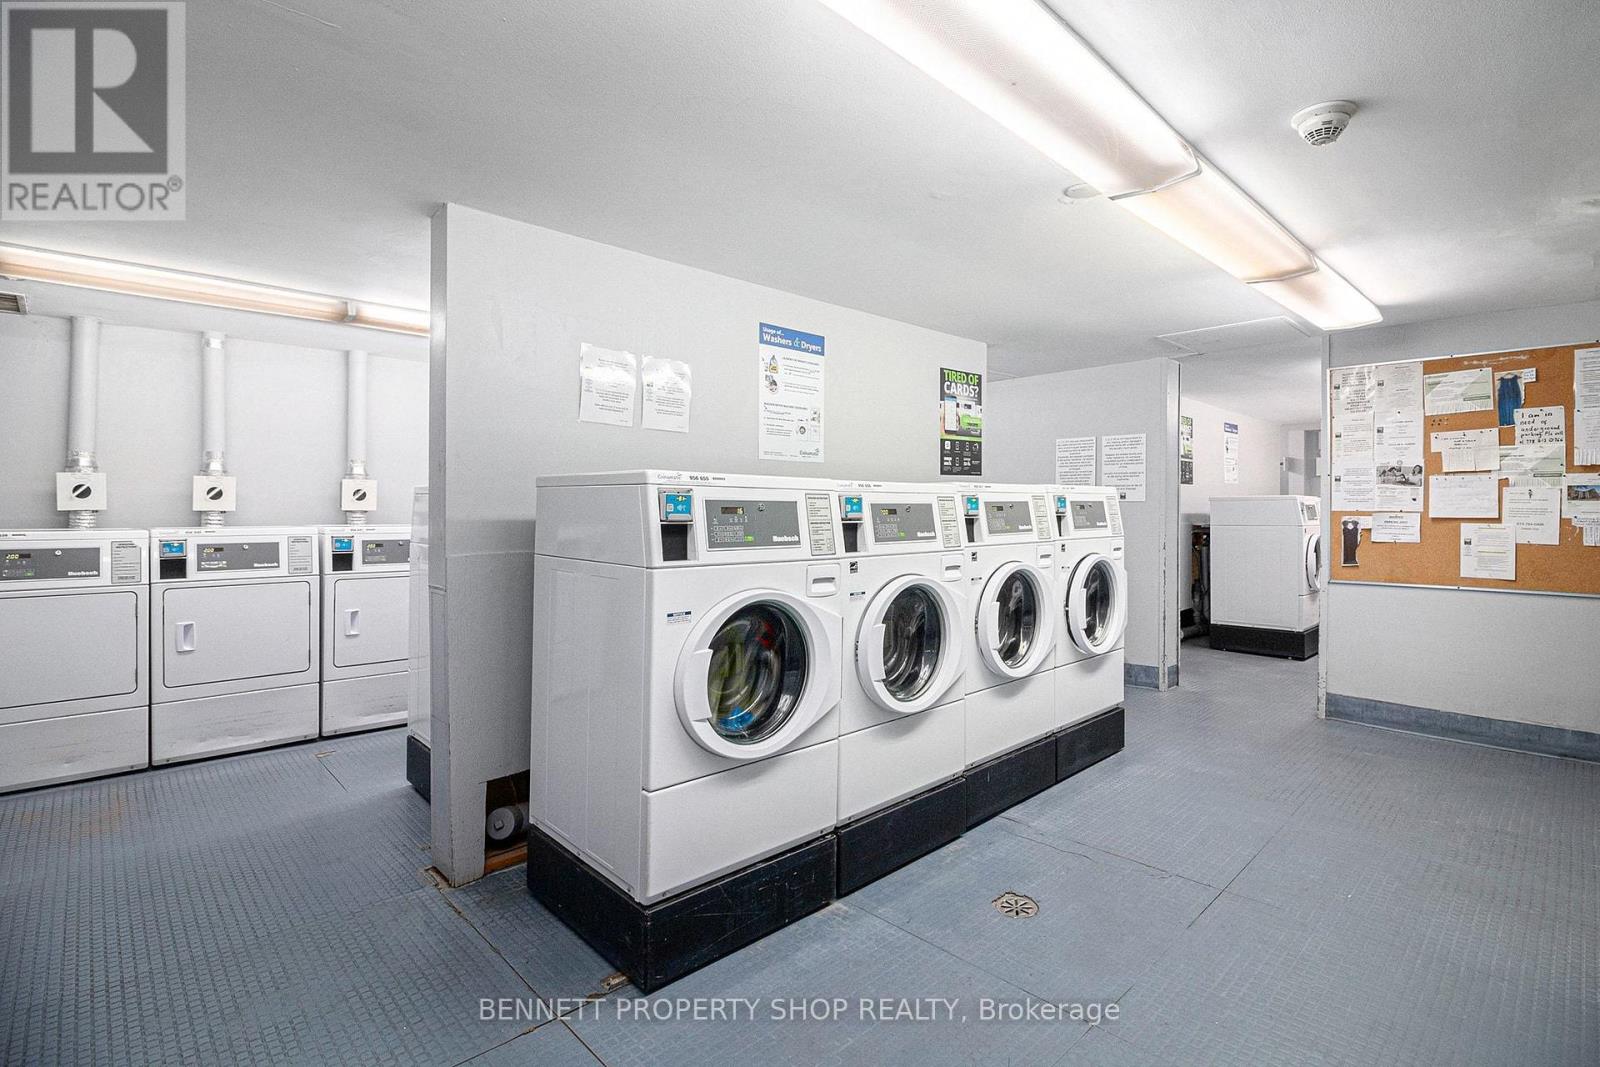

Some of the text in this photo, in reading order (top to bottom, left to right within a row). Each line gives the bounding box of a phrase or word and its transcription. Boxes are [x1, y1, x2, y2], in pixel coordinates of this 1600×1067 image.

[762, 332, 822, 352] Washers & Dryers
[943, 369, 979, 386] TIRED OF
[943, 381, 979, 398] CARDS?
[1520, 431, 1542, 439] parking
[1521, 425, 1560, 433] underground
